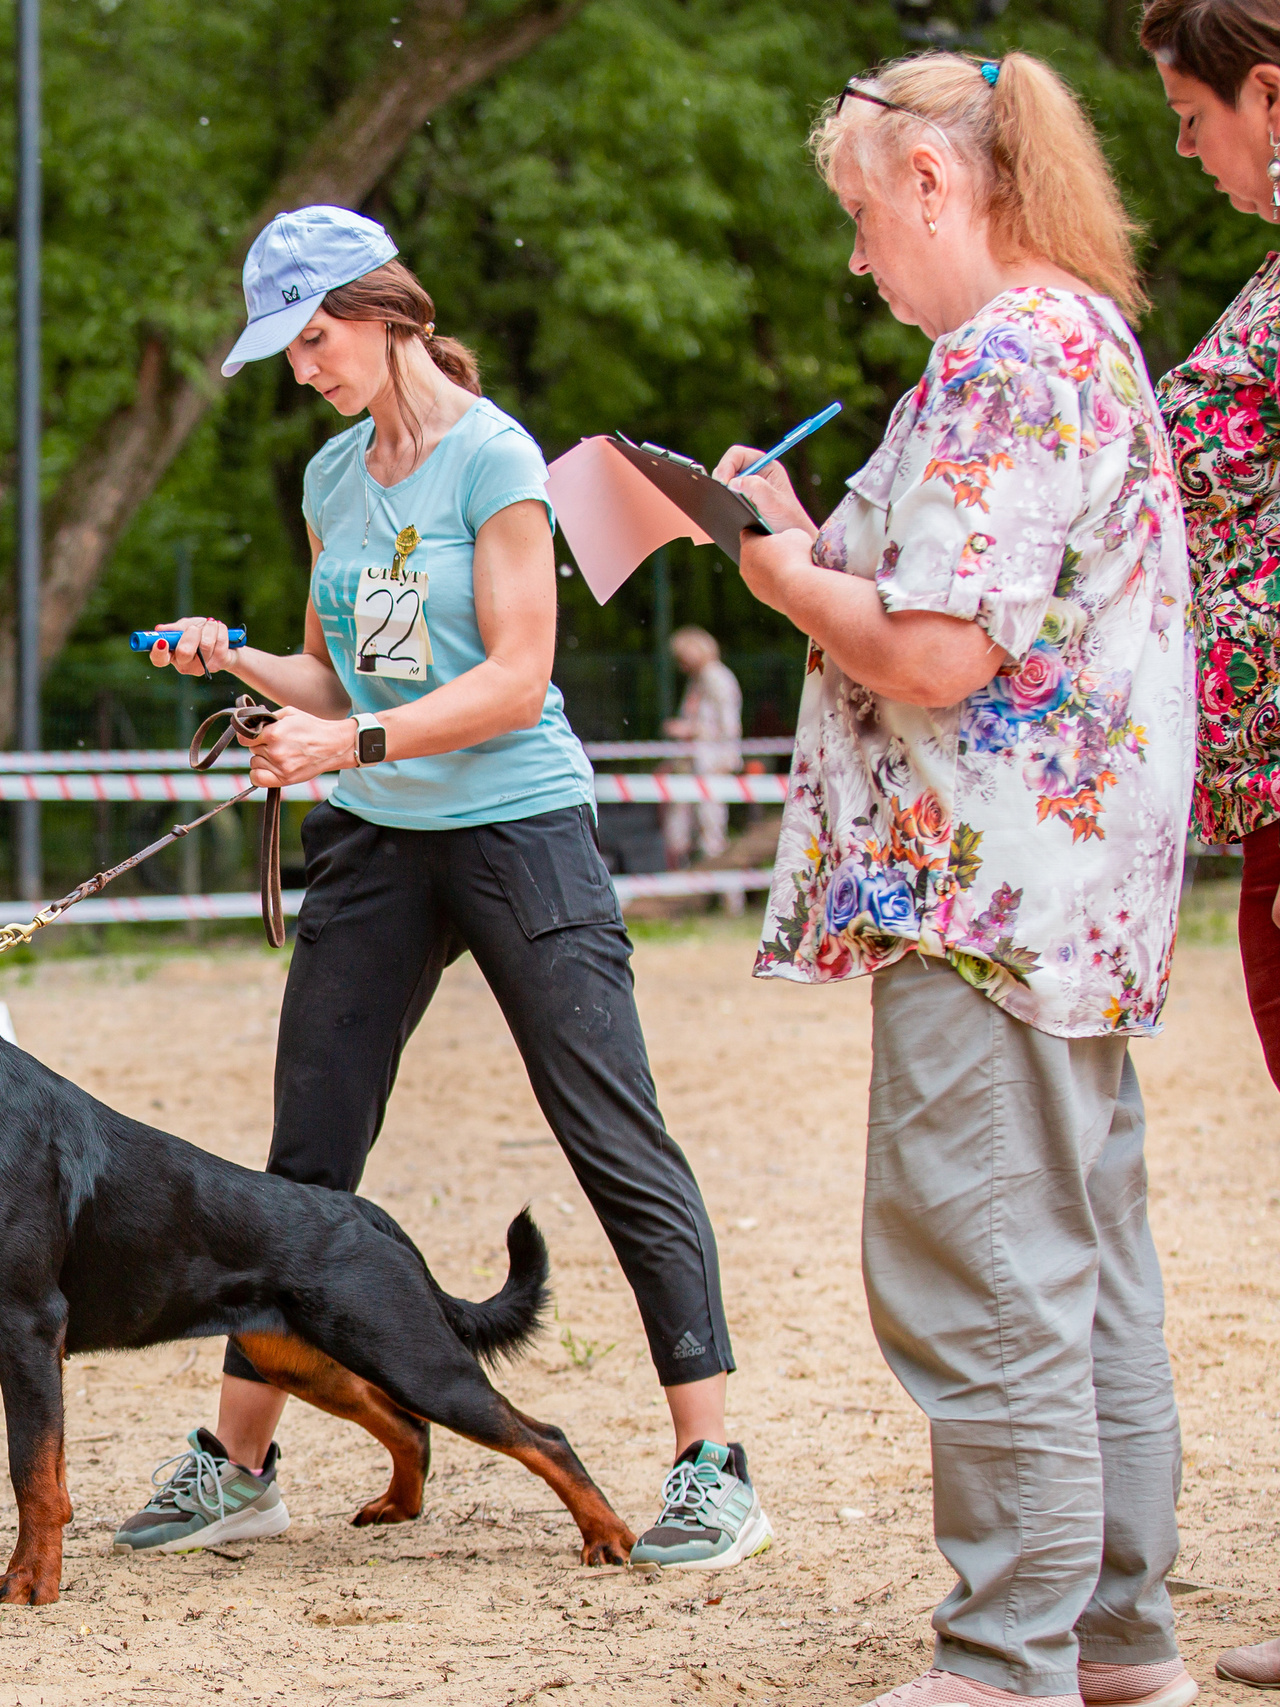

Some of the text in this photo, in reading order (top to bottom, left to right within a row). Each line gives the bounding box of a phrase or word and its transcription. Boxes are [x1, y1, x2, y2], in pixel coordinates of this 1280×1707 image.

[367, 567, 421, 587] Стут
[361, 588, 420, 665] 22
[672, 1345, 707, 1360] adidas
